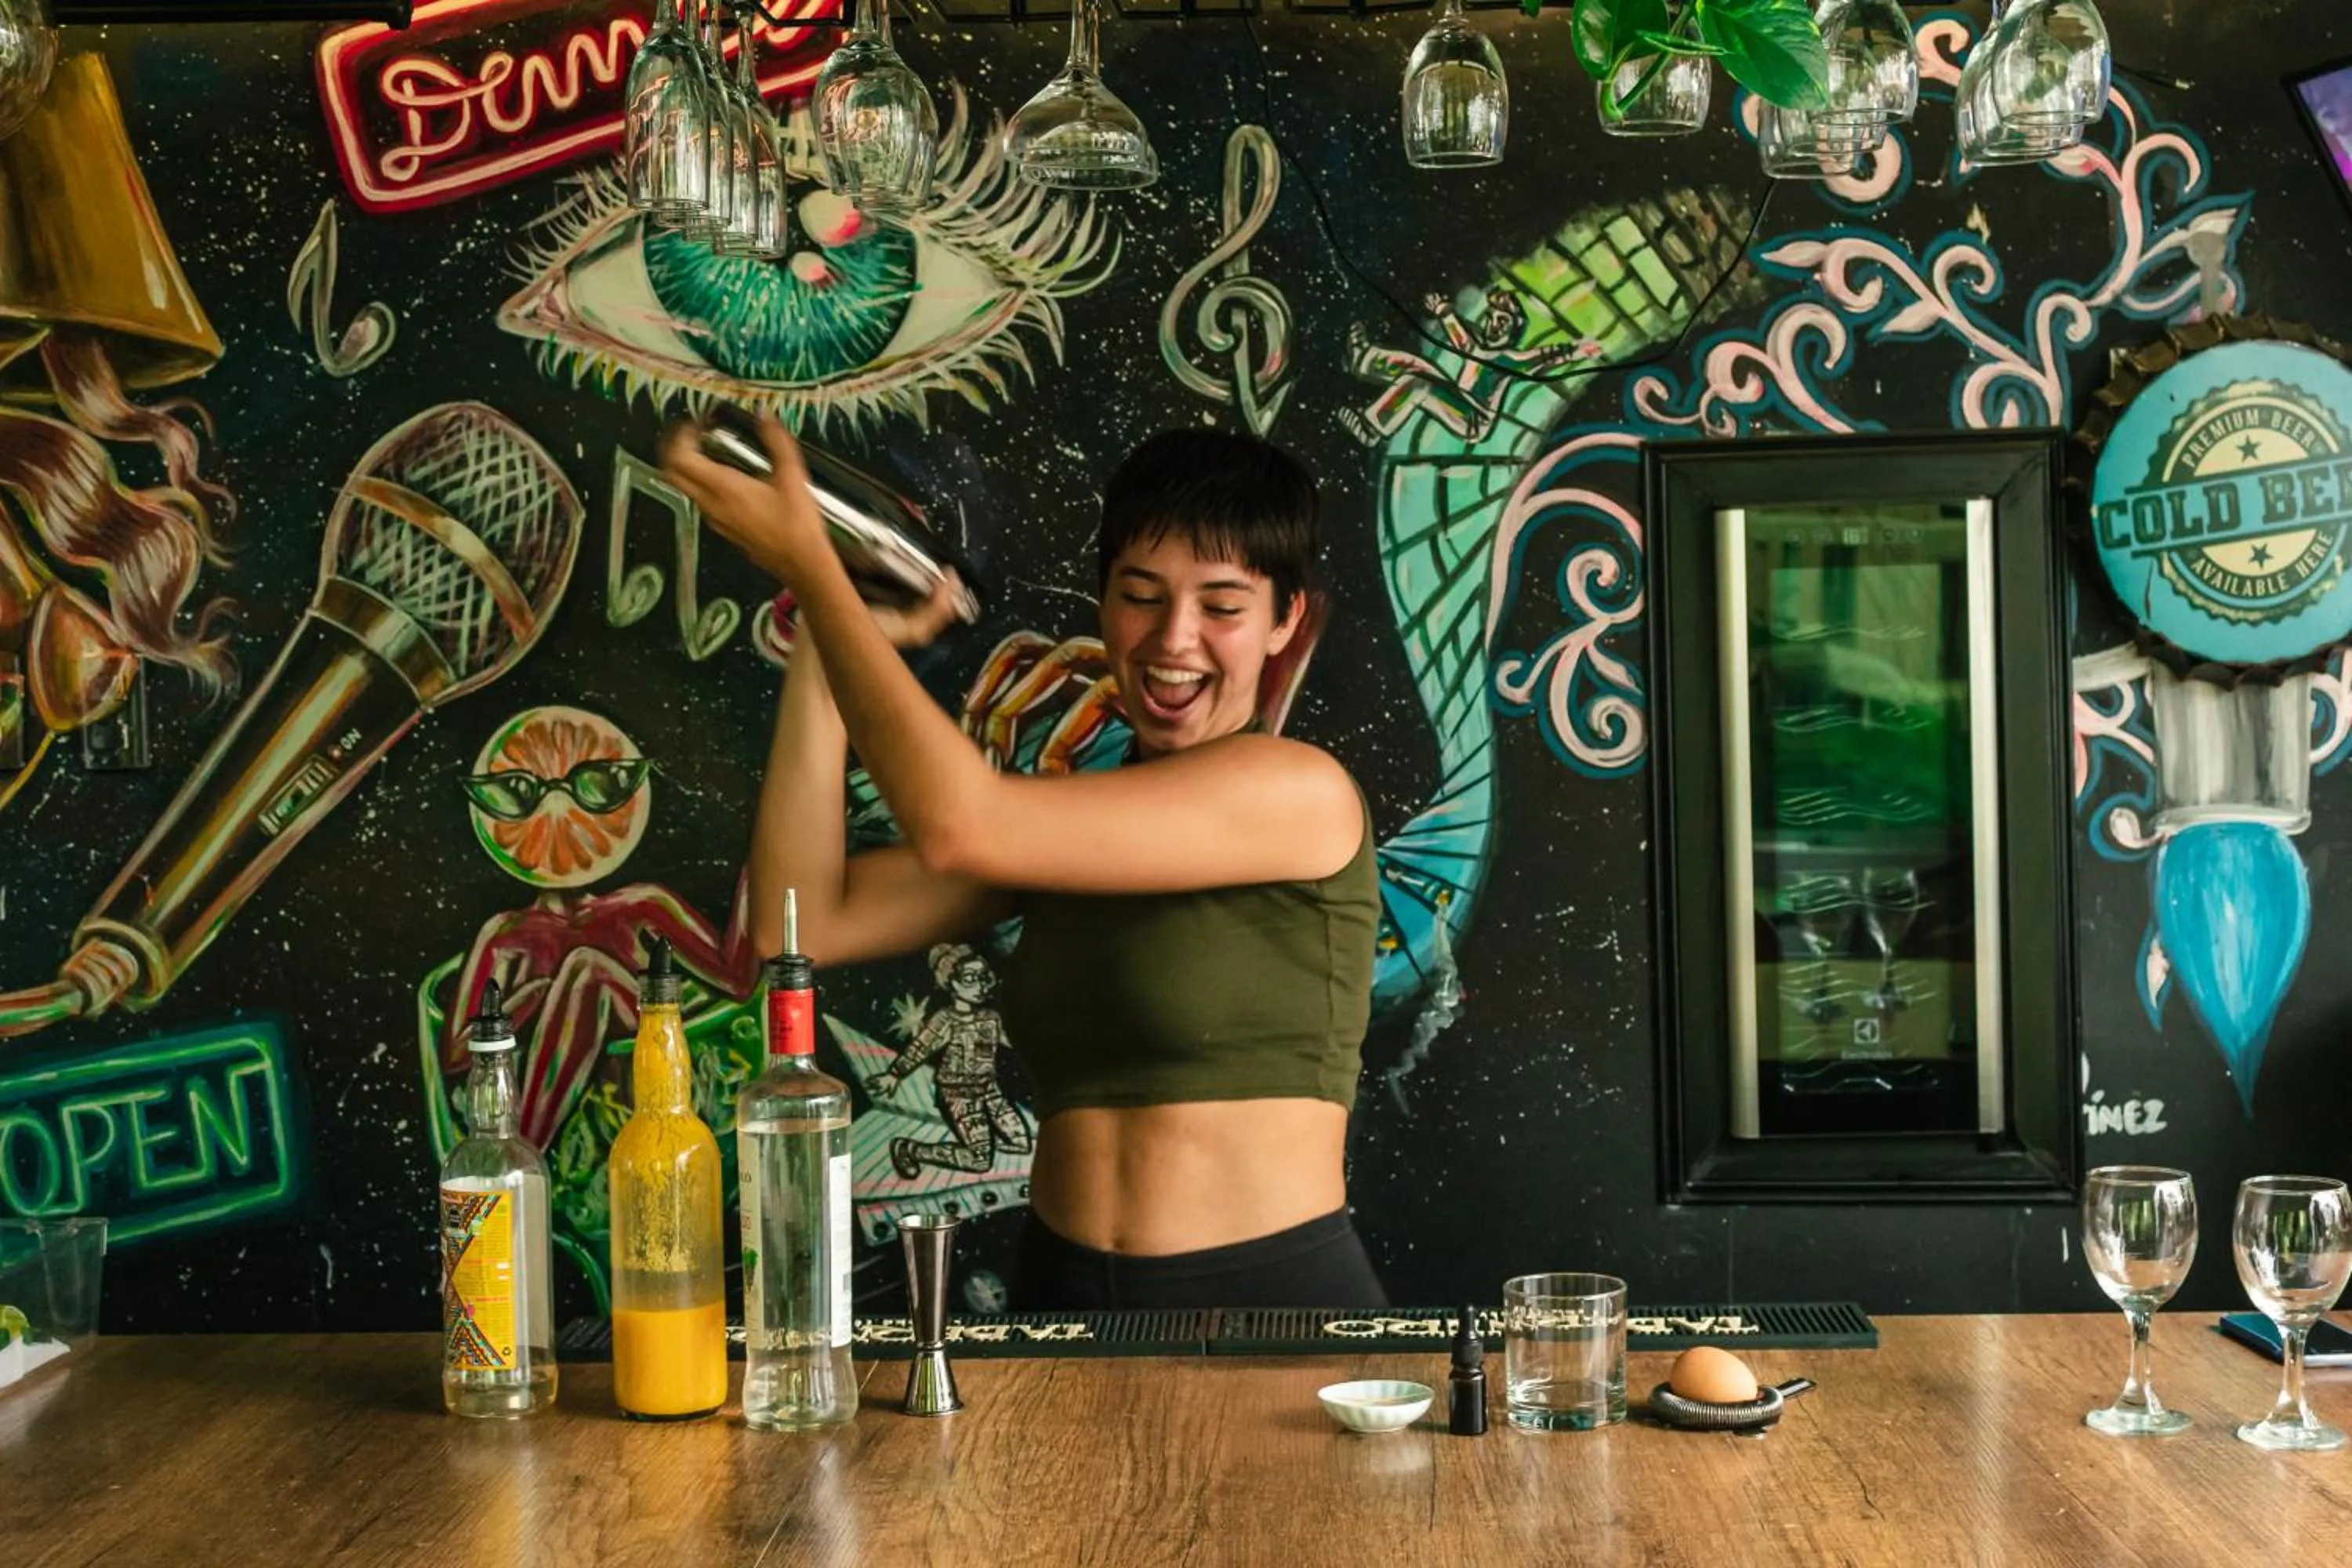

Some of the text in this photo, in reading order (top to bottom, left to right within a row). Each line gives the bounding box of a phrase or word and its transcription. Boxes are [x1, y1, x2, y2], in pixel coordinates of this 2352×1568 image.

[2182, 408, 2317, 468] PREMIUM BEER
[2098, 481, 2241, 550] COLD
[2191, 530, 2335, 598] AVAILABLE HERE
[0, 1068, 251, 1217] OPEN
